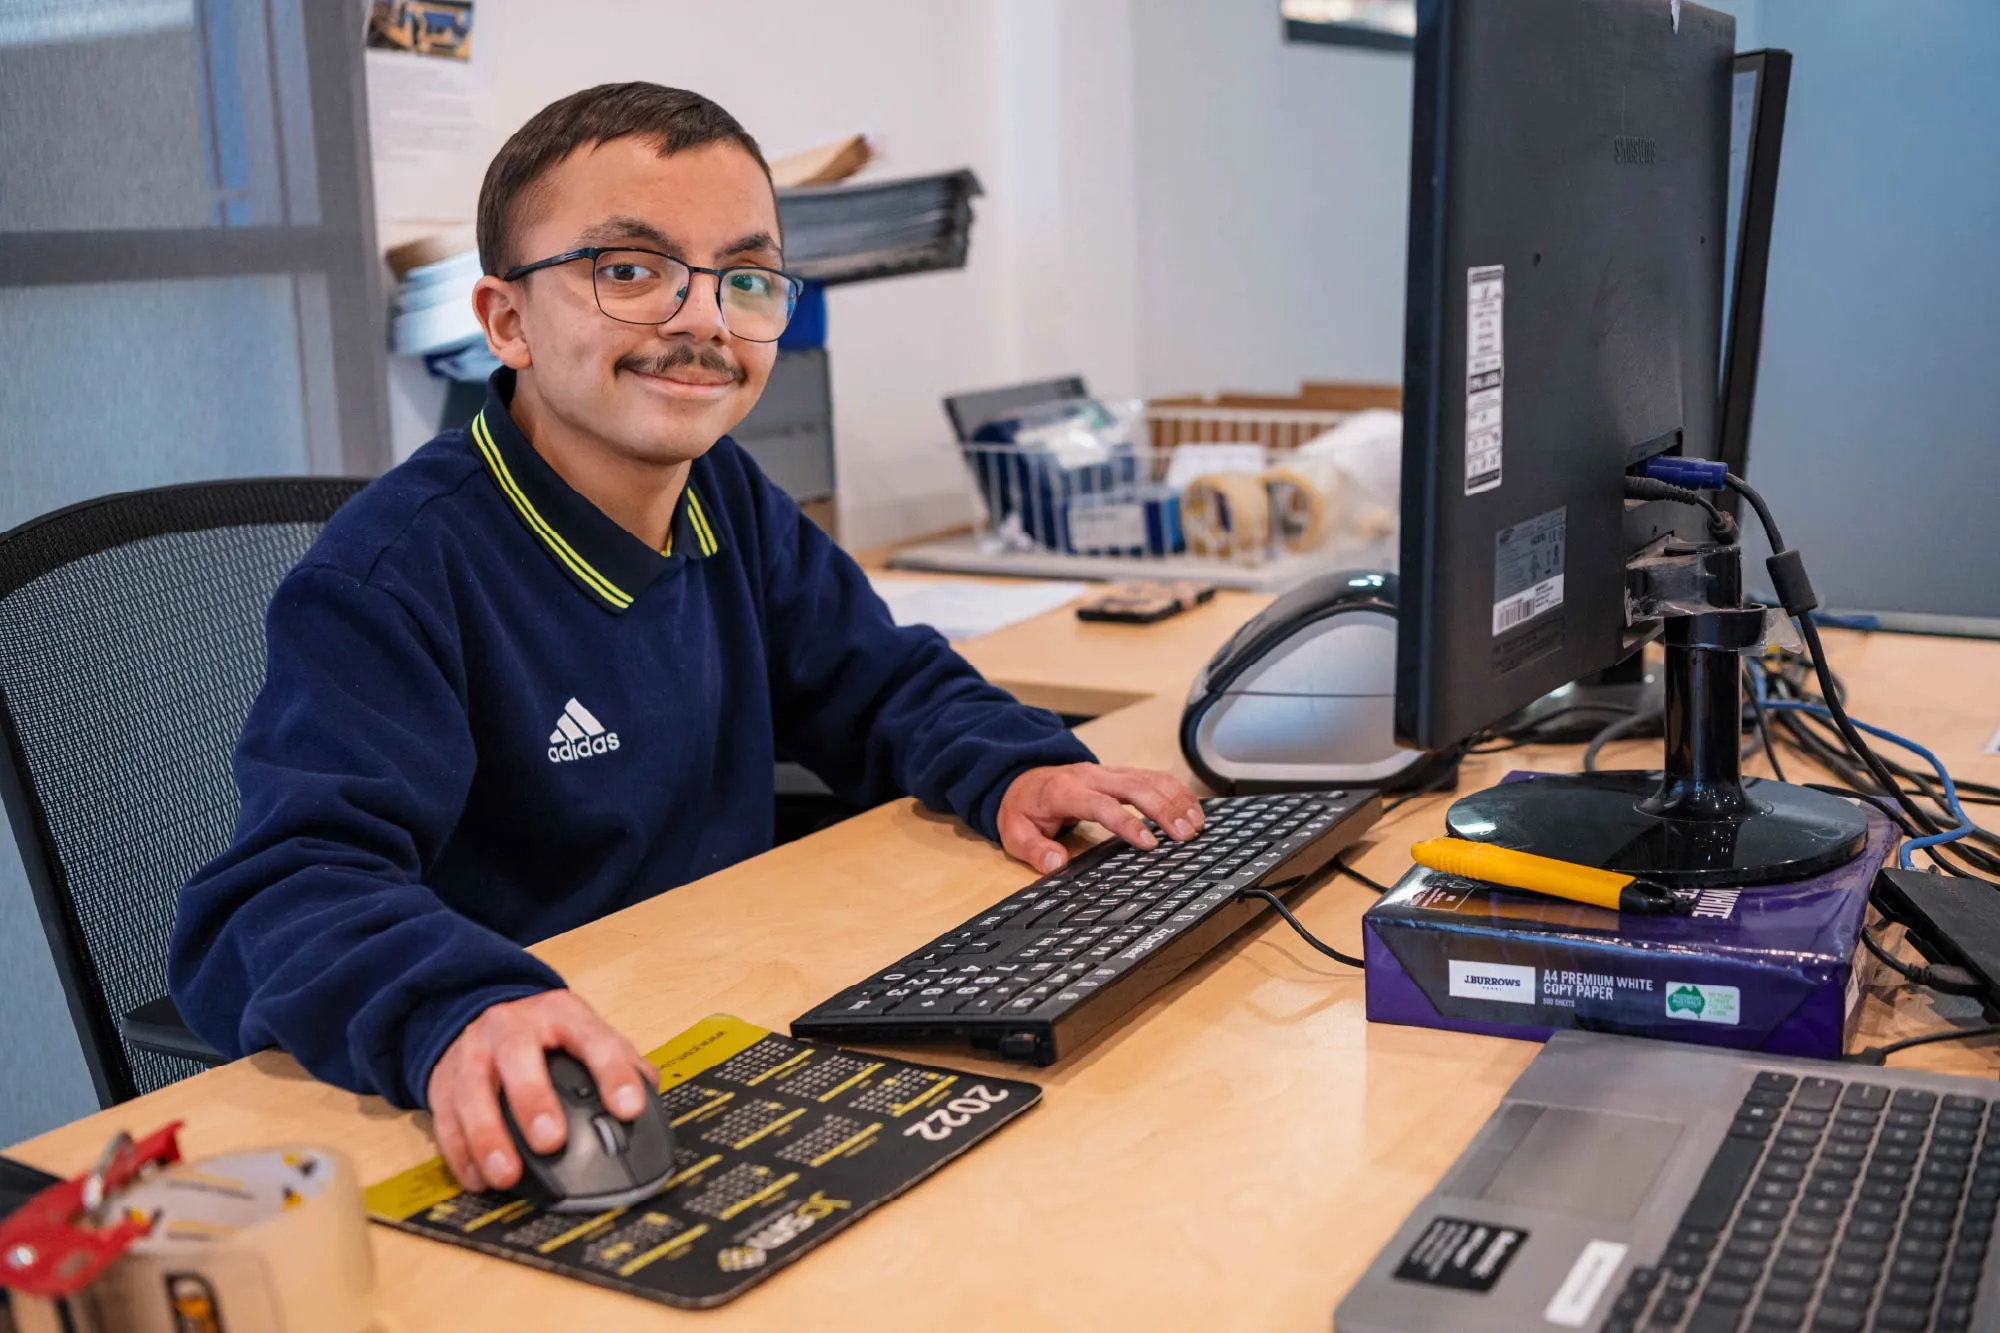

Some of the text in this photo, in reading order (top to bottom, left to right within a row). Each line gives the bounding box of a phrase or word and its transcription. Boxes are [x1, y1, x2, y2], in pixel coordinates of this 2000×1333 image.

[548, 732, 620, 763] adidas
[1144, 911, 1165, 919] F12
[1121, 928, 1175, 958] ZoomText
[1464, 975, 1521, 987] J.BURROWS
[1543, 969, 1654, 991] A4 PREMIUM WHITE
[1543, 983, 1614, 1001] COPY PAPER
[1555, 998, 1575, 1008] SHEETS
[903, 1084, 1009, 1140] 2022
